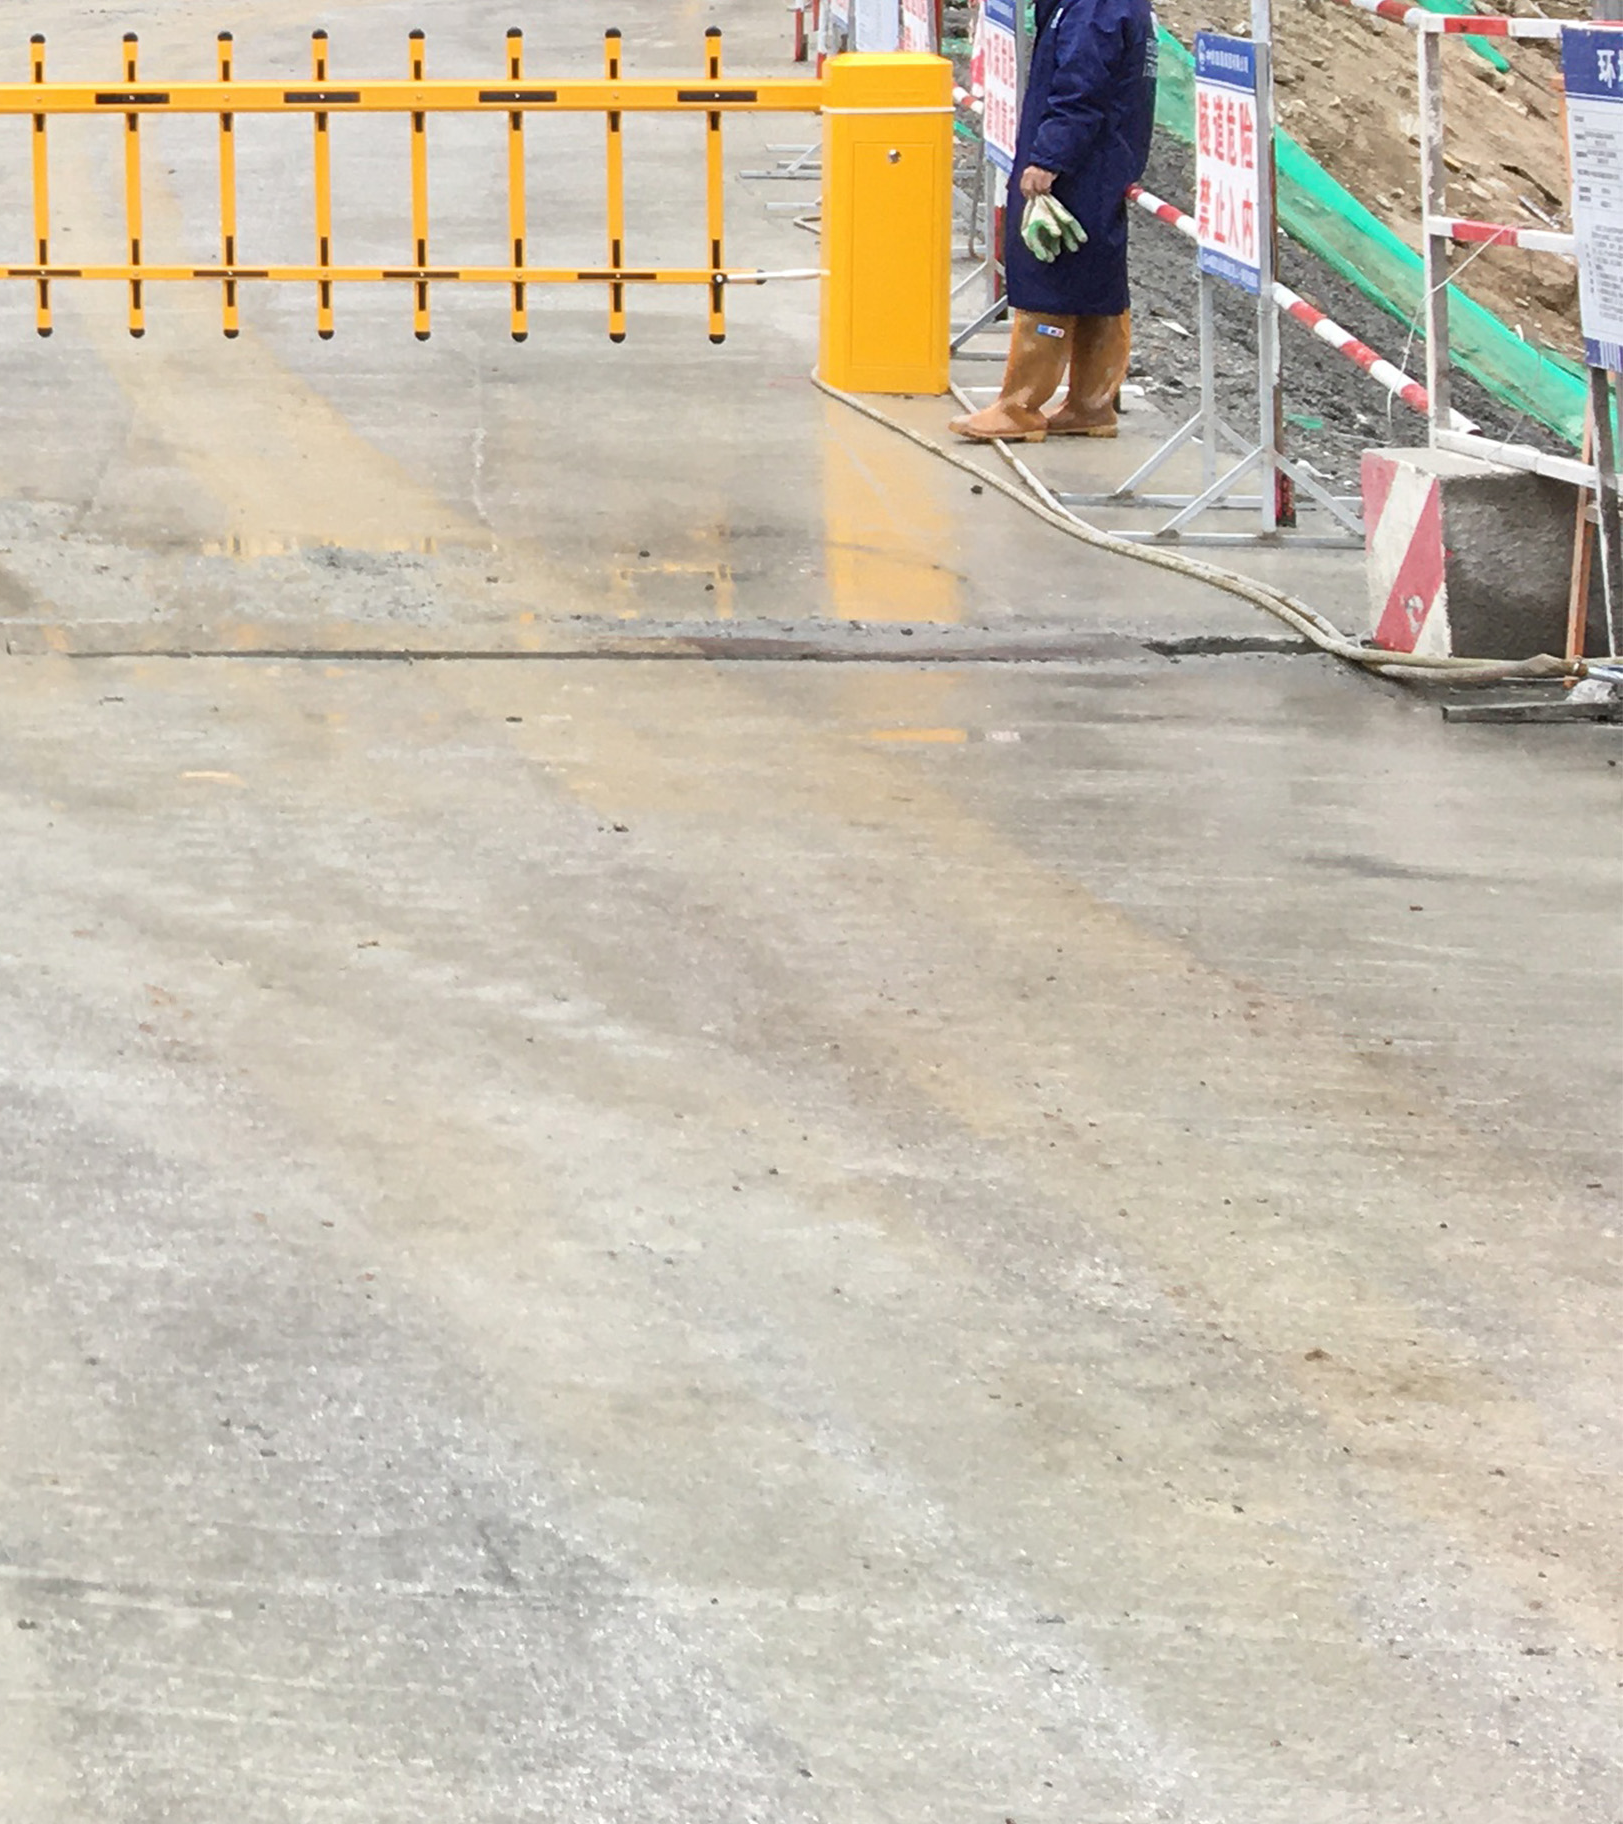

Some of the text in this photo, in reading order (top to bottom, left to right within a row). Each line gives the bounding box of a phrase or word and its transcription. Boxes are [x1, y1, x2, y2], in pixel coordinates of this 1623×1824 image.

[1596, 49, 1623, 88] 环
[1198, 171, 1254, 260] 禁止入内
